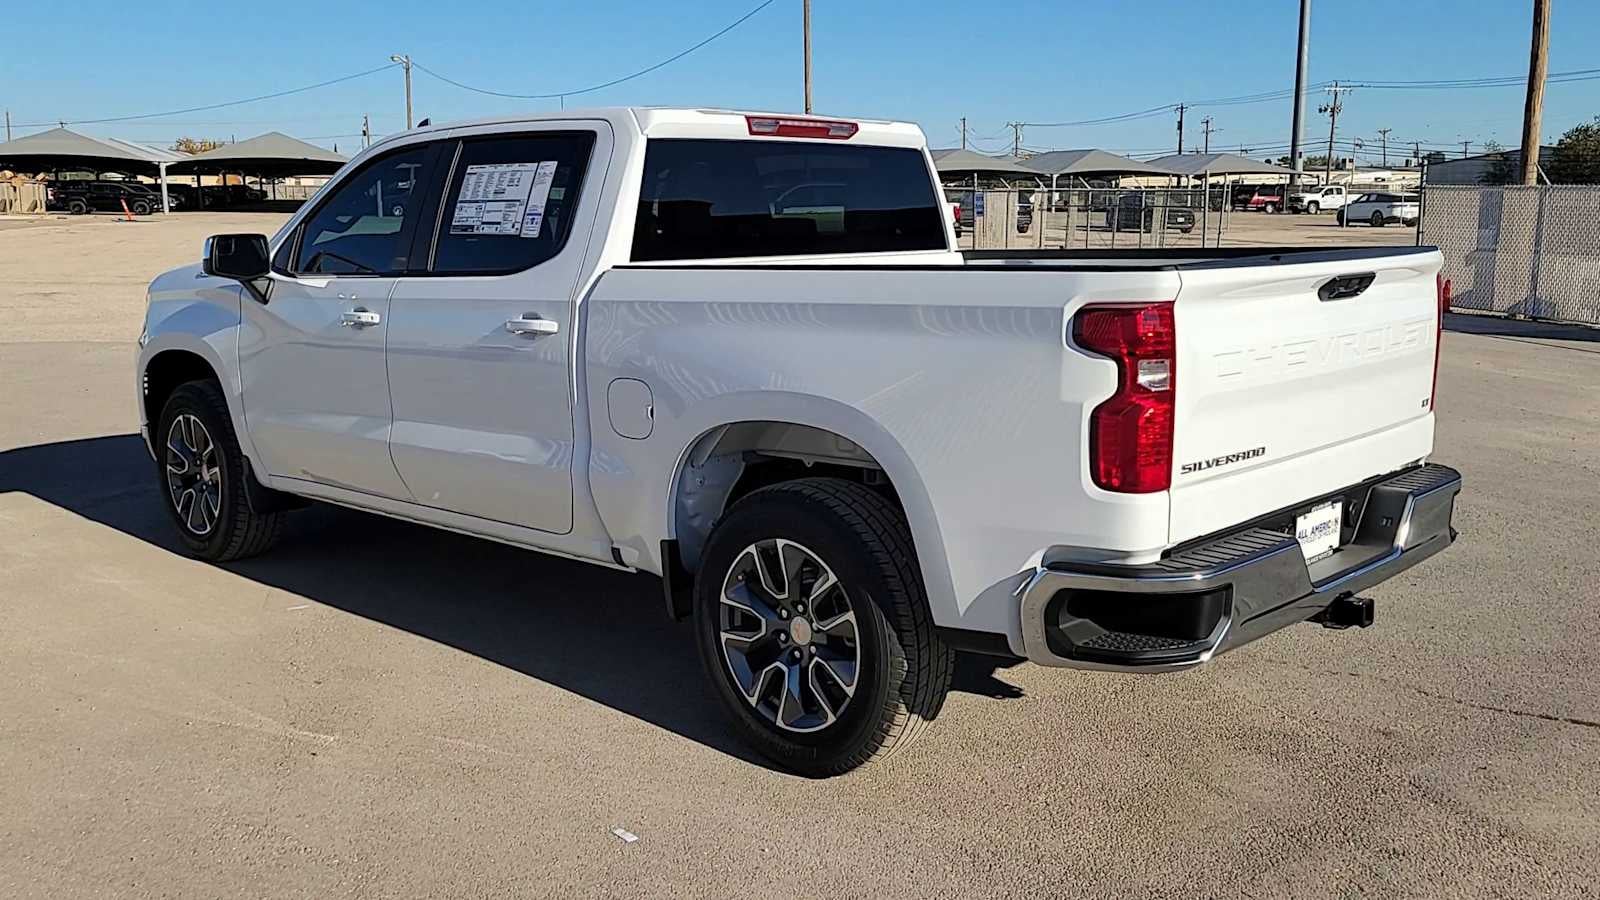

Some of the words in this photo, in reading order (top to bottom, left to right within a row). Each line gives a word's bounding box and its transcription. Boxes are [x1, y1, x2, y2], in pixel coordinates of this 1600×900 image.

[1213, 318, 1432, 378] CHEVROLET
[1180, 446, 1266, 475] SILVERADO
[1298, 529, 1308, 539] ALL
[1311, 517, 1339, 536] AMERICN
